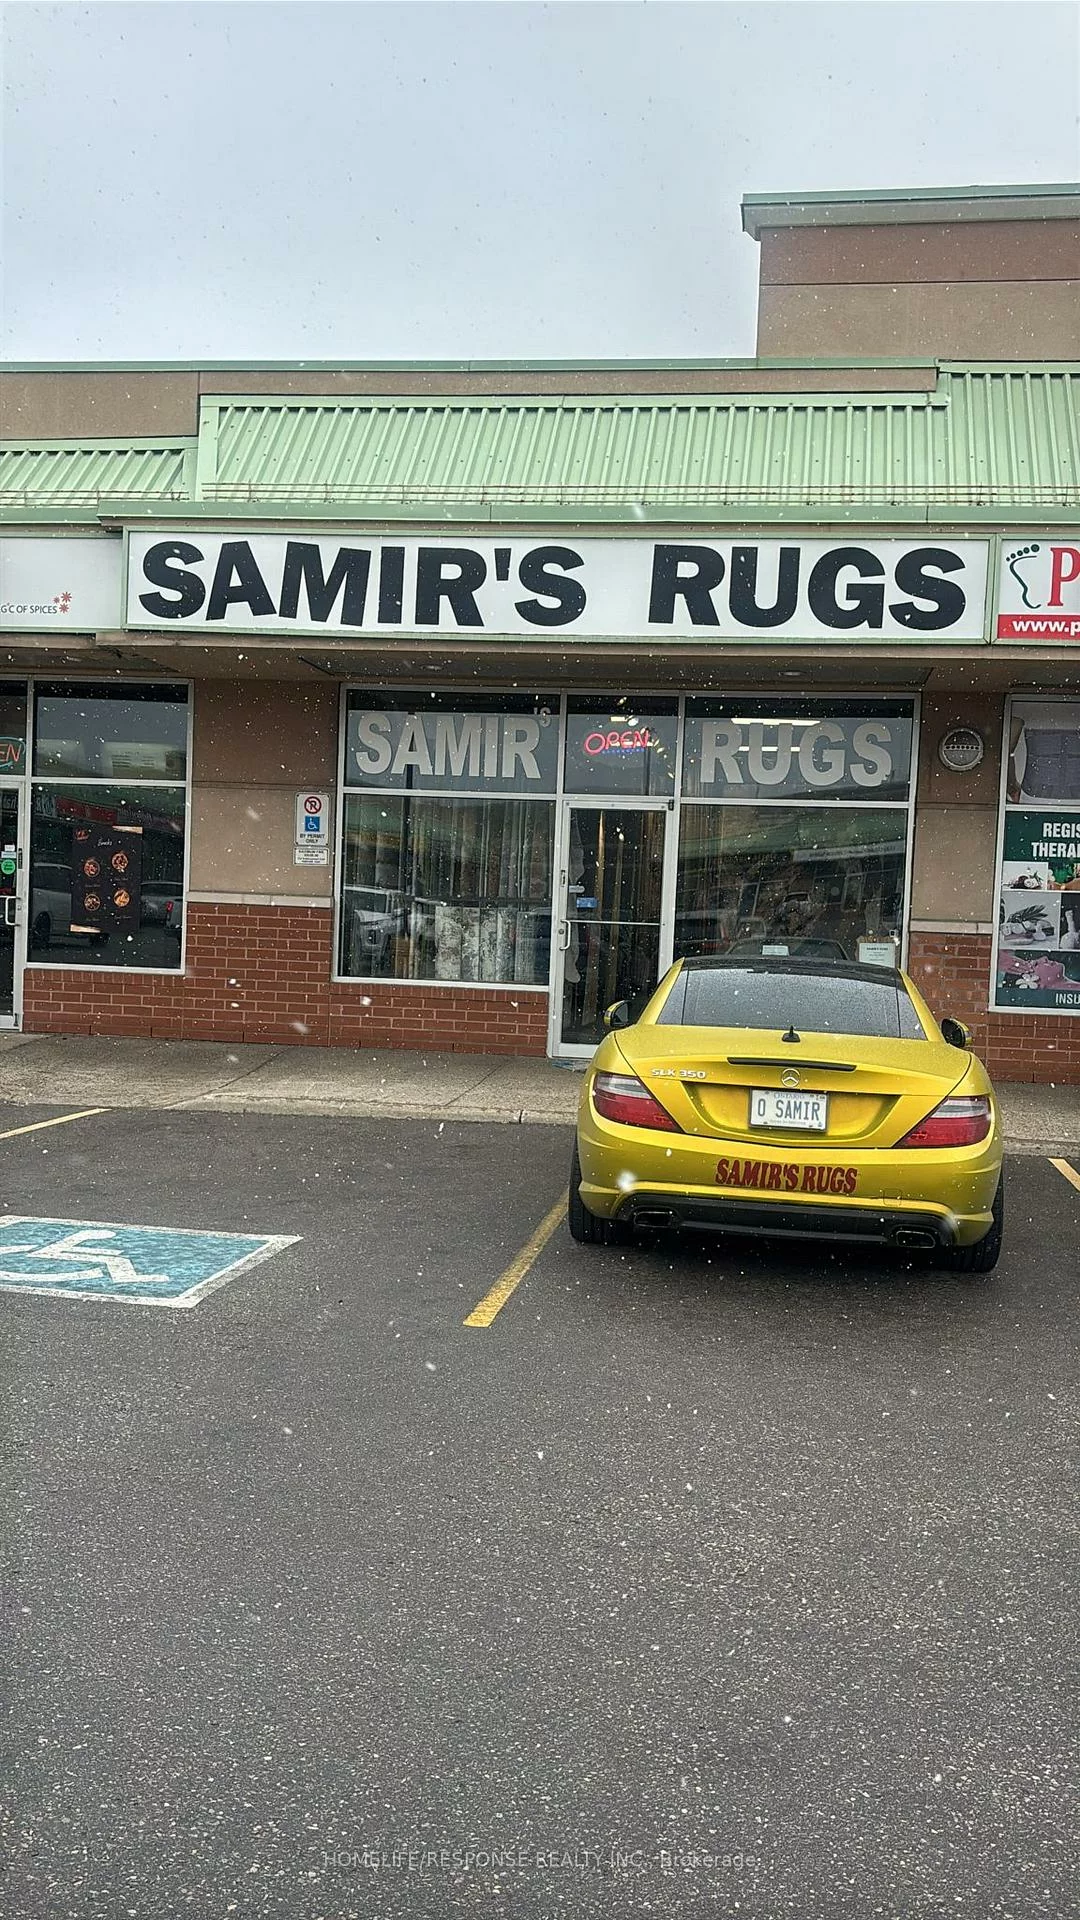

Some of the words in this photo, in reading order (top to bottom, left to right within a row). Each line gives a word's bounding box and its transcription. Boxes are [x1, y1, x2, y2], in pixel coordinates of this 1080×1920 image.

[139, 541, 587, 627] SAMIR'S
[648, 544, 967, 631] RUGS
[16, 605, 28, 613] OF
[30, 605, 57, 614] SPICES
[584, 729, 649, 755] OPEN
[701, 722, 892, 787] RUGS
[651, 1068, 676, 1077] SLK
[679, 1069, 706, 1079] 350
[775, 1100, 820, 1121] SAMIR
[715, 1158, 799, 1190] SAMIR'S
[801, 1165, 858, 1194] RUGS
